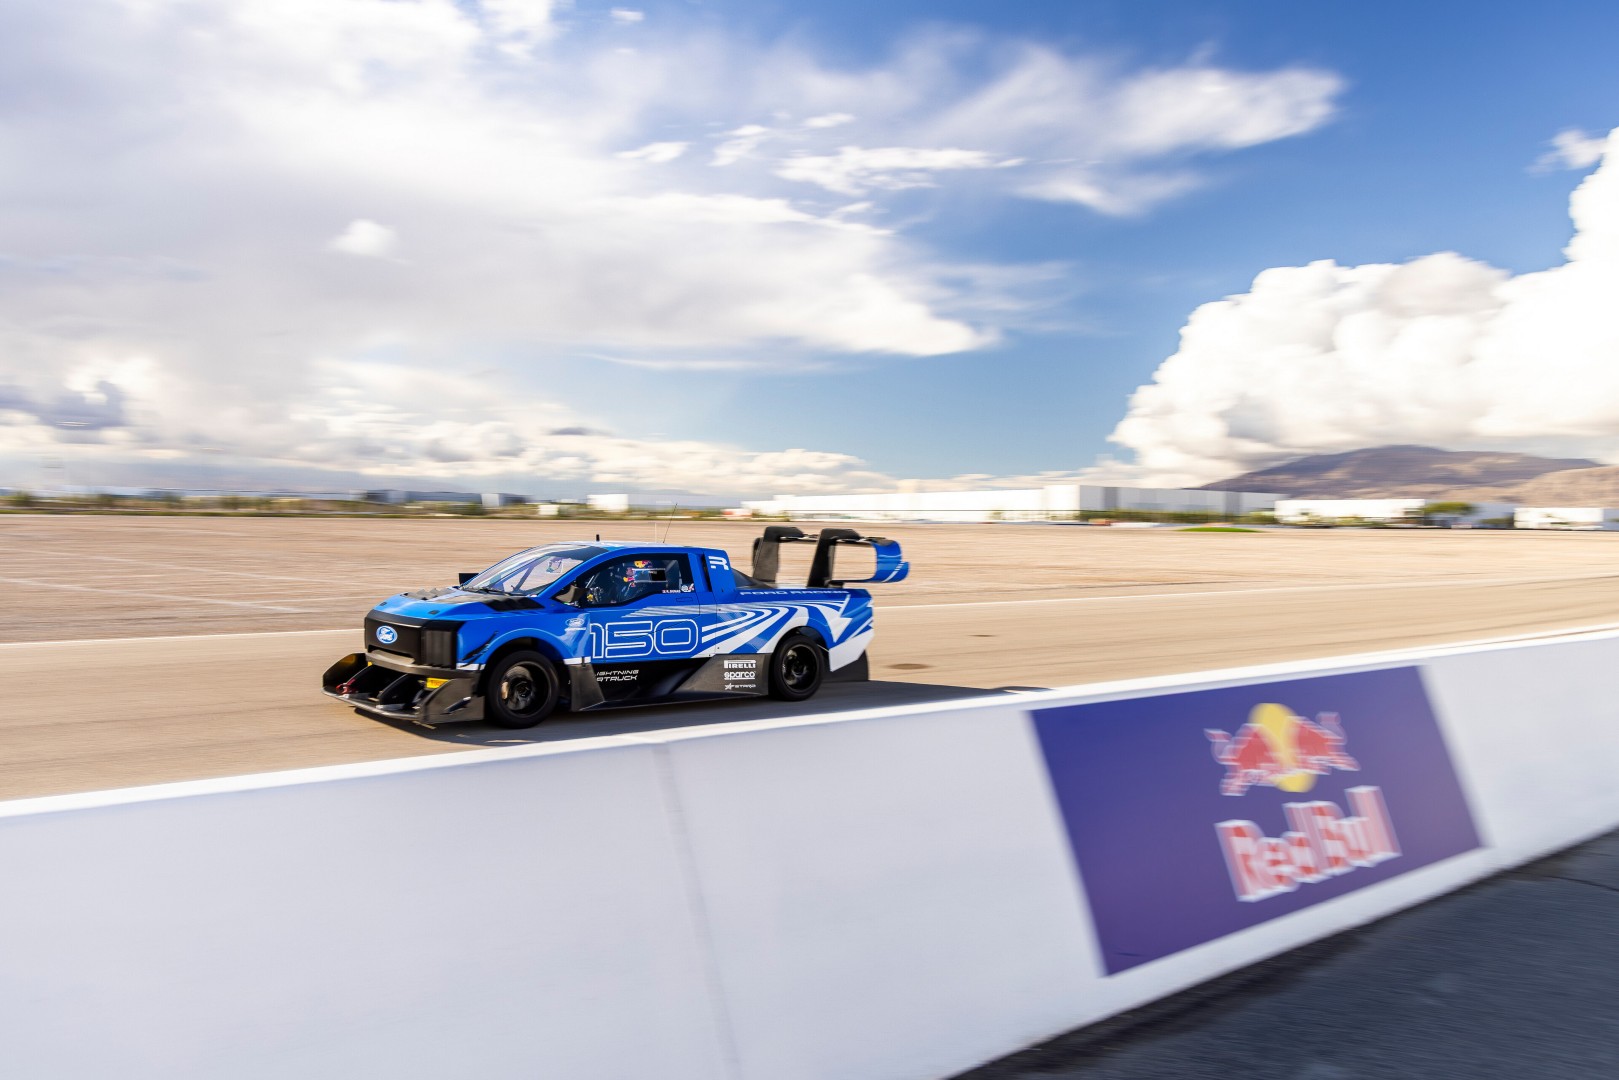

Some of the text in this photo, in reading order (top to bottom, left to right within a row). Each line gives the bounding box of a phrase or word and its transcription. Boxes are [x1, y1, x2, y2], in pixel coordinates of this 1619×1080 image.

[589, 619, 699, 659] 150
[723, 659, 757, 669] PIRELLI
[723, 671, 756, 681] sparco
[1214, 785, 1401, 903] Red Bull
